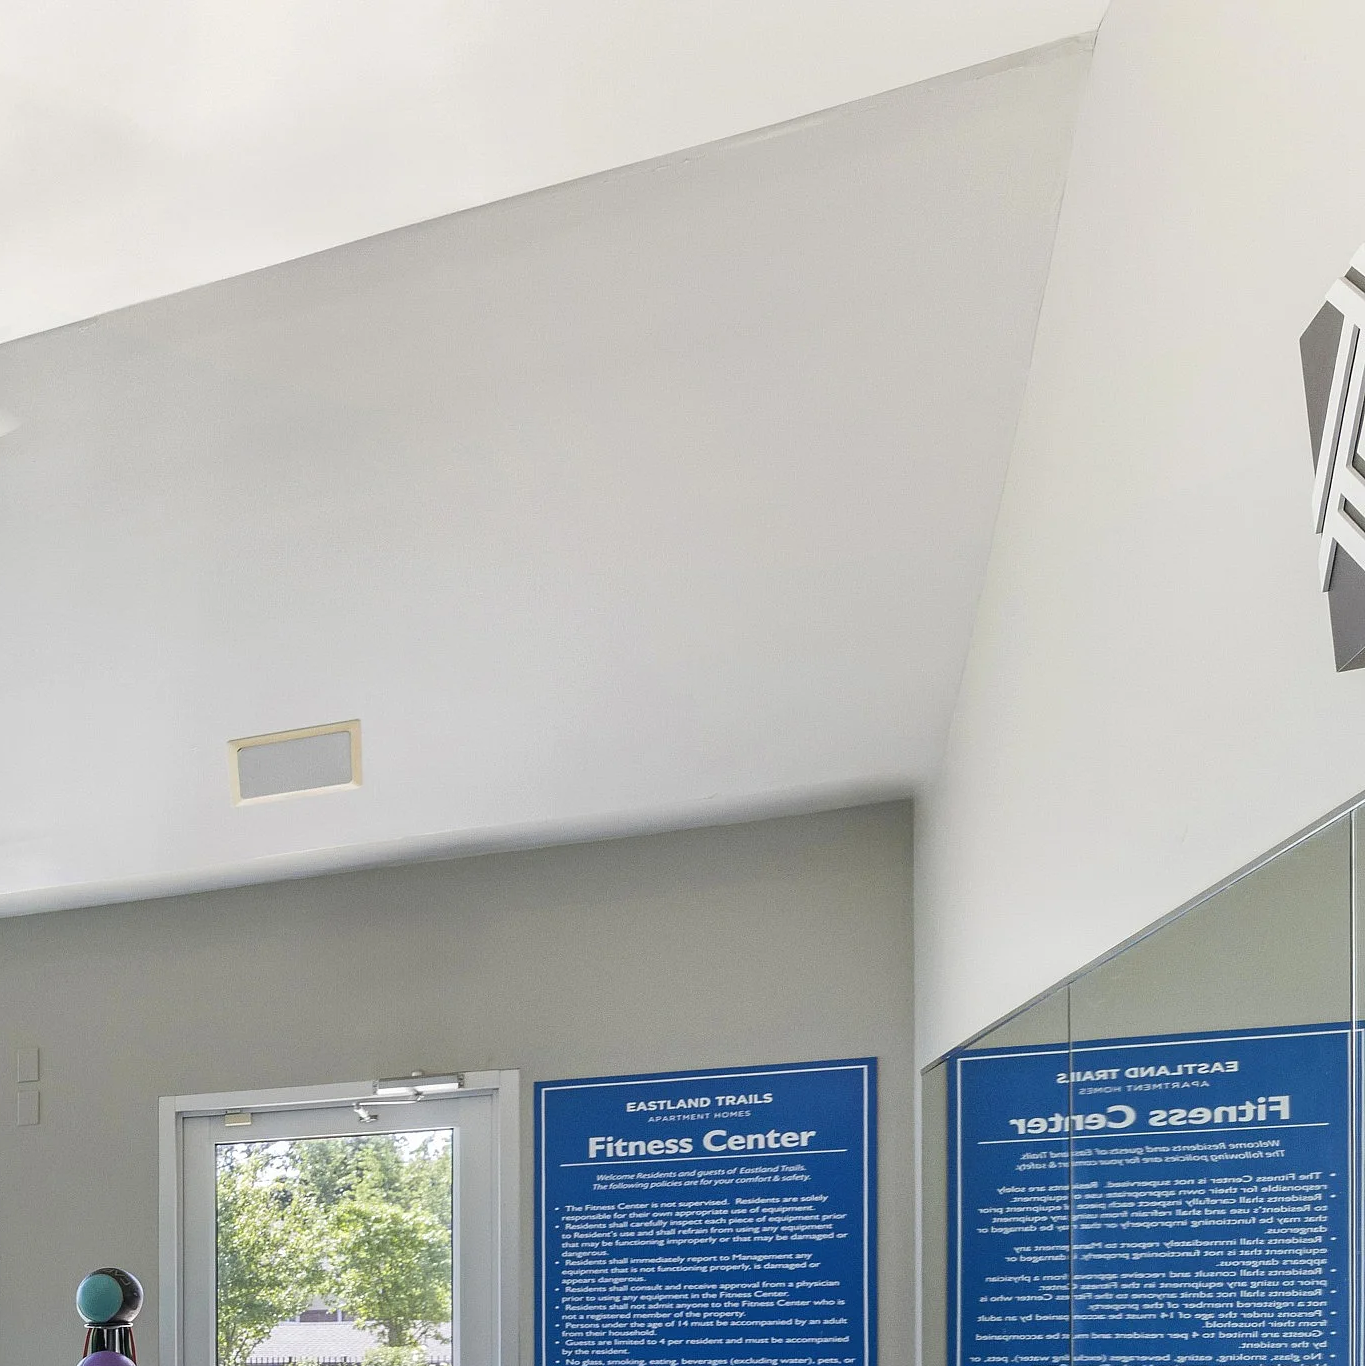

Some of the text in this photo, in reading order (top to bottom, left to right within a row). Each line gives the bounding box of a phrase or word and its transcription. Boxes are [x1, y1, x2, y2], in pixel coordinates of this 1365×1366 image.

[626, 1093, 773, 1112] EASTLAND TRAILS
[648, 1110, 751, 1123] APARTMENT HOMES
[588, 1128, 816, 1159] Fitness Center
[596, 1172, 635, 1181] Welcome
[635, 1170, 677, 1179] Residents
[677, 1169, 696, 1177] and
[696, 1168, 725, 1177] guests
[738, 1165, 779, 1174] Eastland
[780, 1163, 806, 1172] Trails.
[608, 1180, 649, 1191] following
[649, 1179, 682, 1189] policies
[713, 1178, 734, 1186] your
[735, 1175, 772, 1183] comfort
[781, 1173, 810, 1183] safety.
[584, 1202, 616, 1211] Fitness
[616, 1201, 649, 1209] Center
[677, 1198, 730, 1208] supervised.
[734, 1196, 780, 1205] Residents
[799, 1194, 828, 1204] solely
[561, 1212, 612, 1222] responsible
[674, 1207, 729, 1218] appropriate
[760, 1204, 815, 1214] equipment.
[729, 1318, 793, 1327] accompanied
[785, 1335, 849, 1345] accompanied
[680, 1357, 728, 1366] beverages
